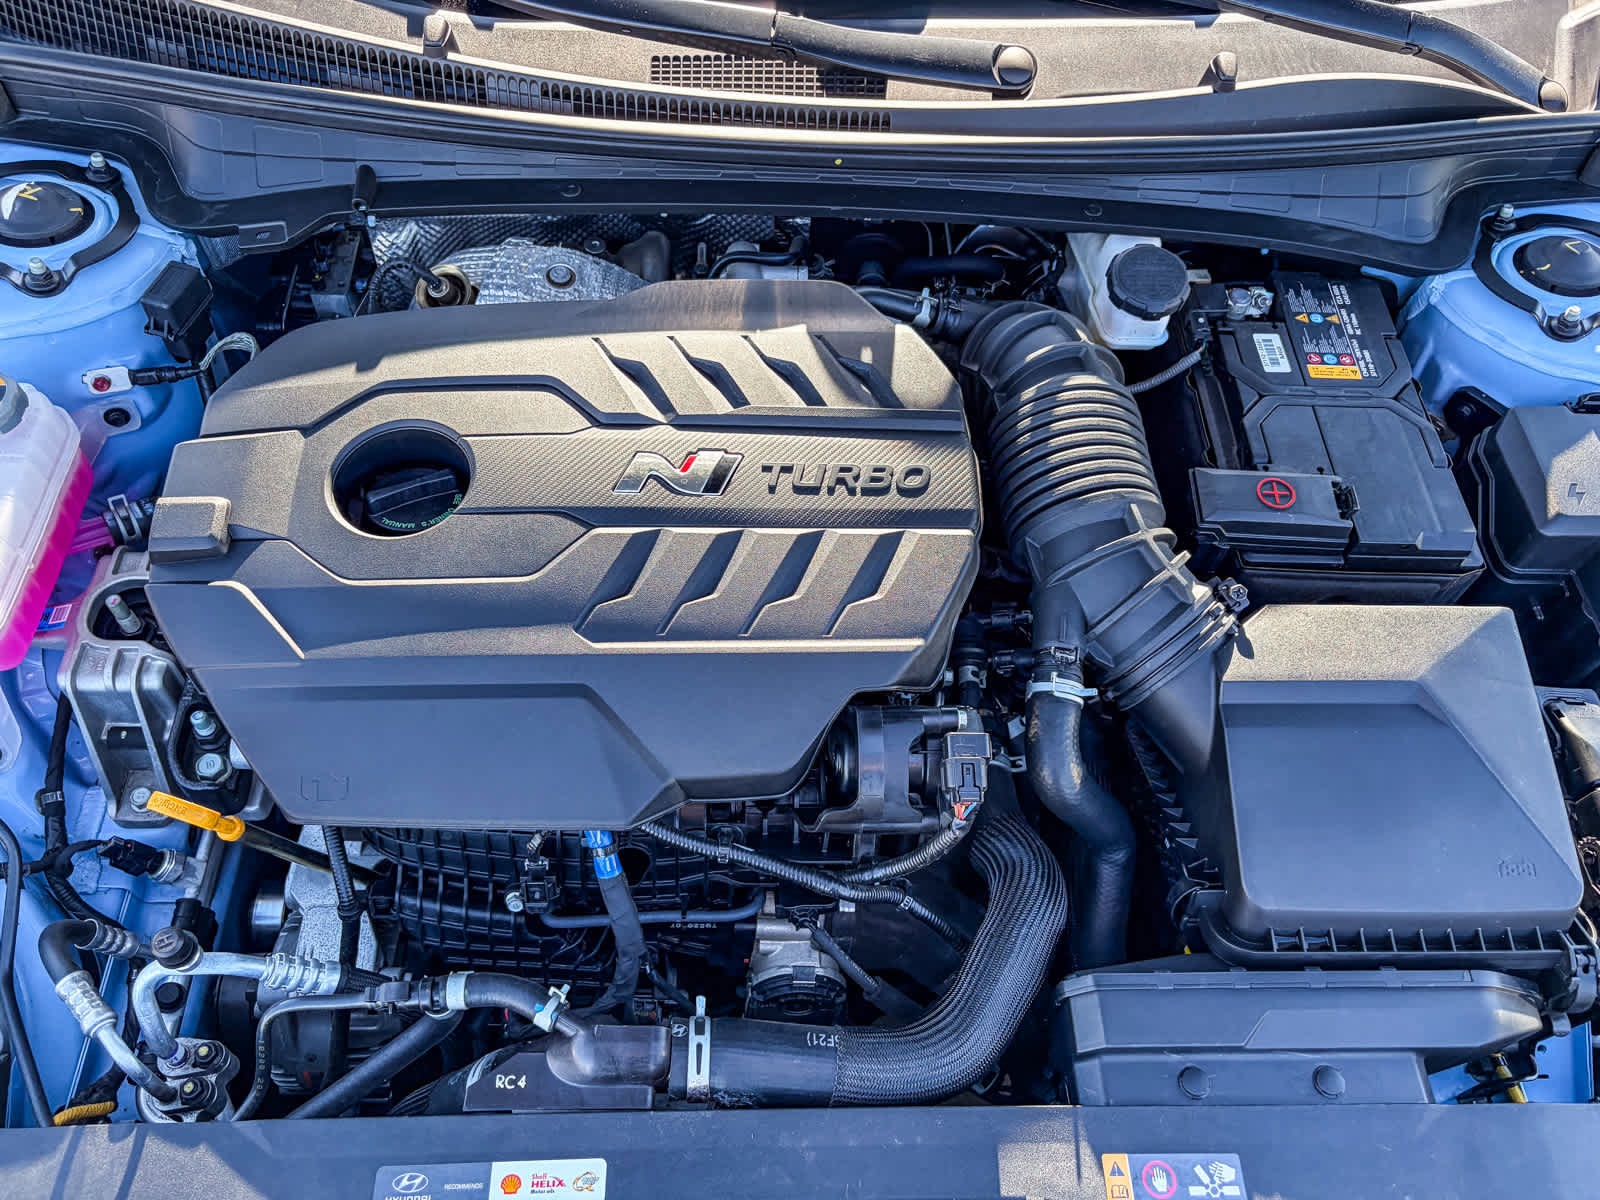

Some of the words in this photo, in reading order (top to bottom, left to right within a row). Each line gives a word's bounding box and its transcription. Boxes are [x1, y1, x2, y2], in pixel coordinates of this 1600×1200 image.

[761, 462, 931, 497] TURBO
[382, 517, 416, 528] MANUAL
[531, 1179, 565, 1188] HELIX
